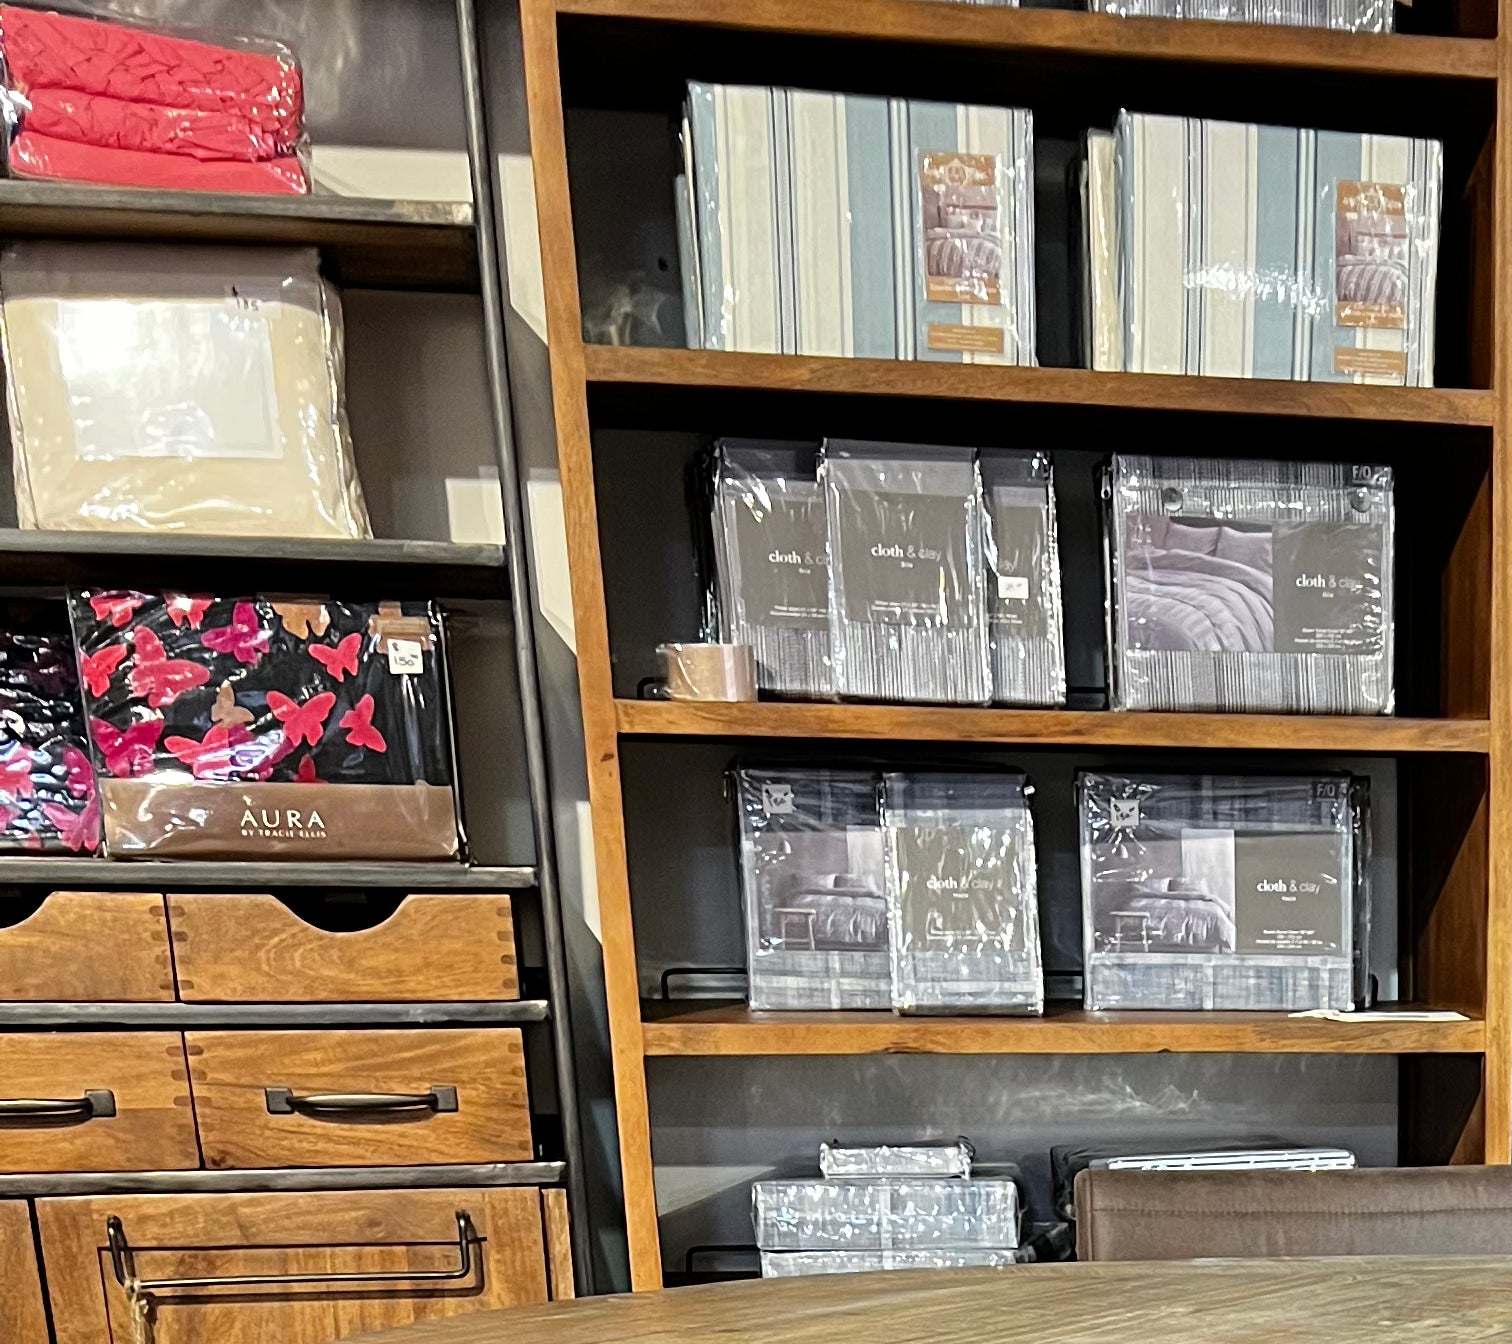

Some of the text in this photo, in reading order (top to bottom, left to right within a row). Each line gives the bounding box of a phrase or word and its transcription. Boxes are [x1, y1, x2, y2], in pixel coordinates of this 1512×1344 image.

[768, 549, 802, 564] cloth
[804, 551, 815, 565] &
[871, 543, 942, 562] cloth & clay
[1295, 573, 1326, 588] cloth
[1328, 574, 1337, 588] &
[241, 810, 325, 829] AURA
[926, 874, 958, 890] cloth
[1256, 879, 1320, 895] cloth & clay
